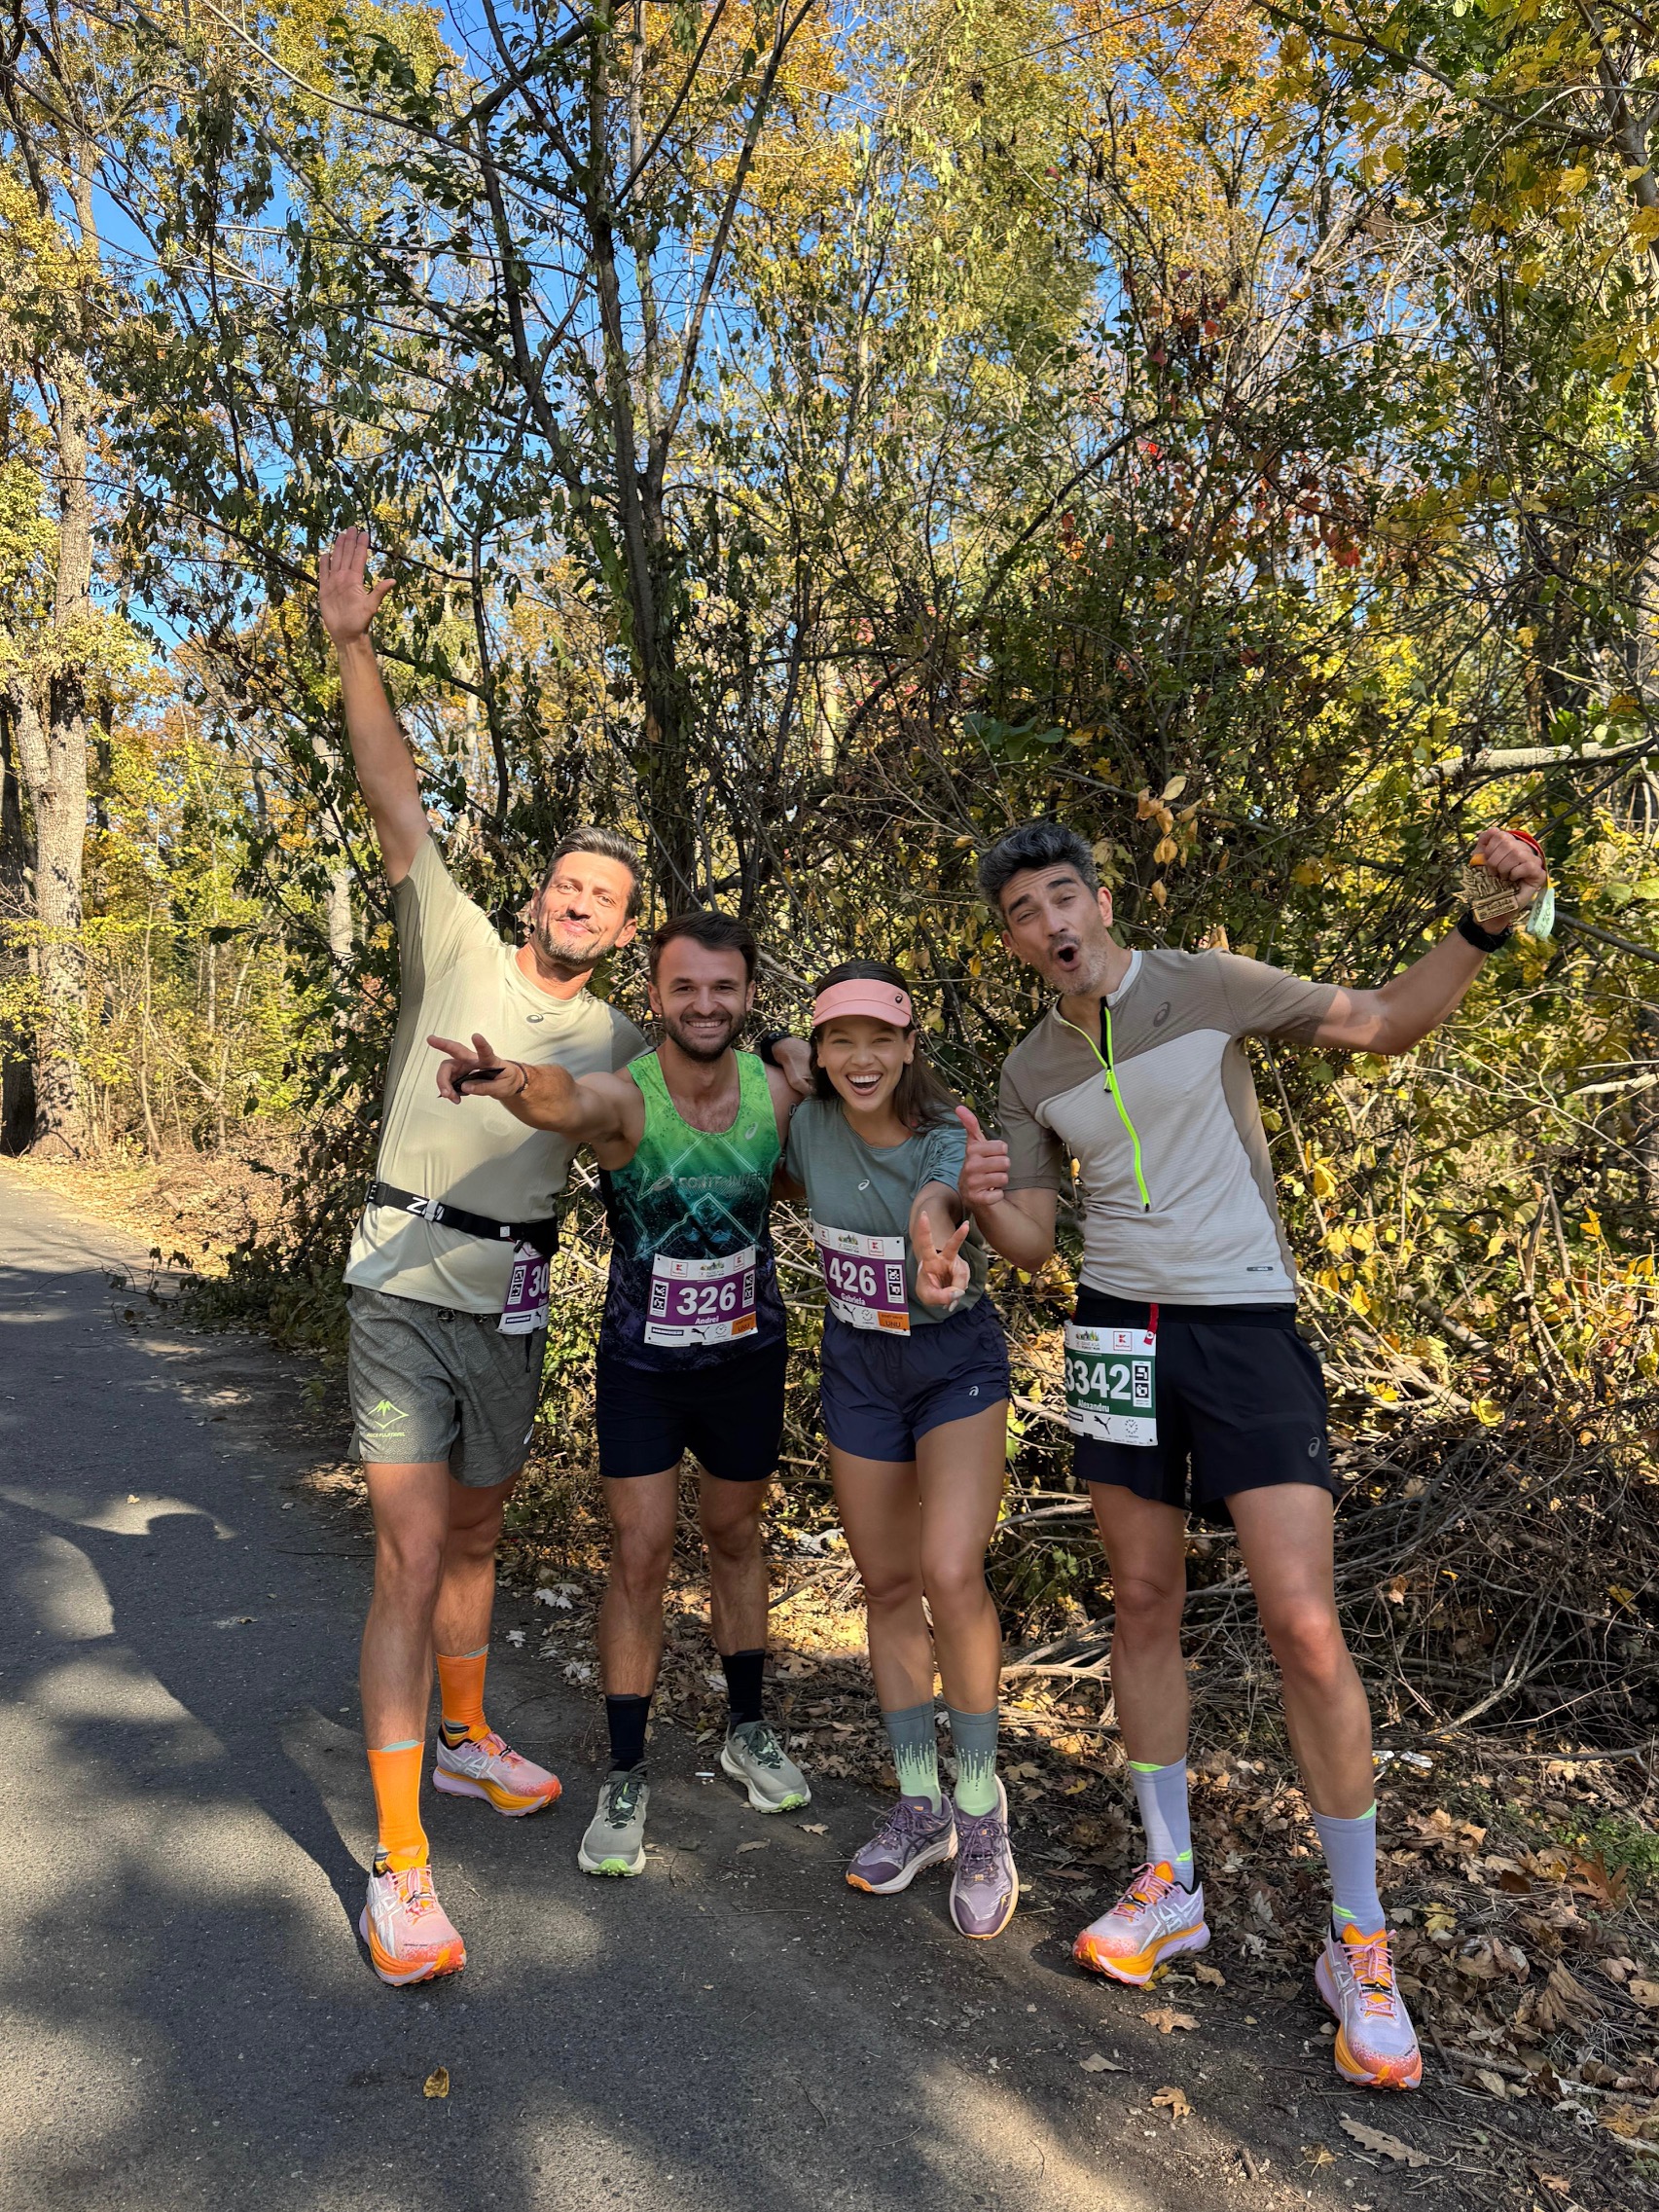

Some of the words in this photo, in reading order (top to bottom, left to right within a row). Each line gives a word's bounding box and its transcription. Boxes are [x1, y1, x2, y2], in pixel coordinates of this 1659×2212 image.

[829, 1257, 877, 1296] 426
[676, 1282, 737, 1316] 326
[841, 1292, 866, 1306] Gabriela
[694, 1315, 720, 1324] Andrei
[1064, 1356, 1132, 1399] 3342
[1077, 1398, 1110, 1413] Alexandru
